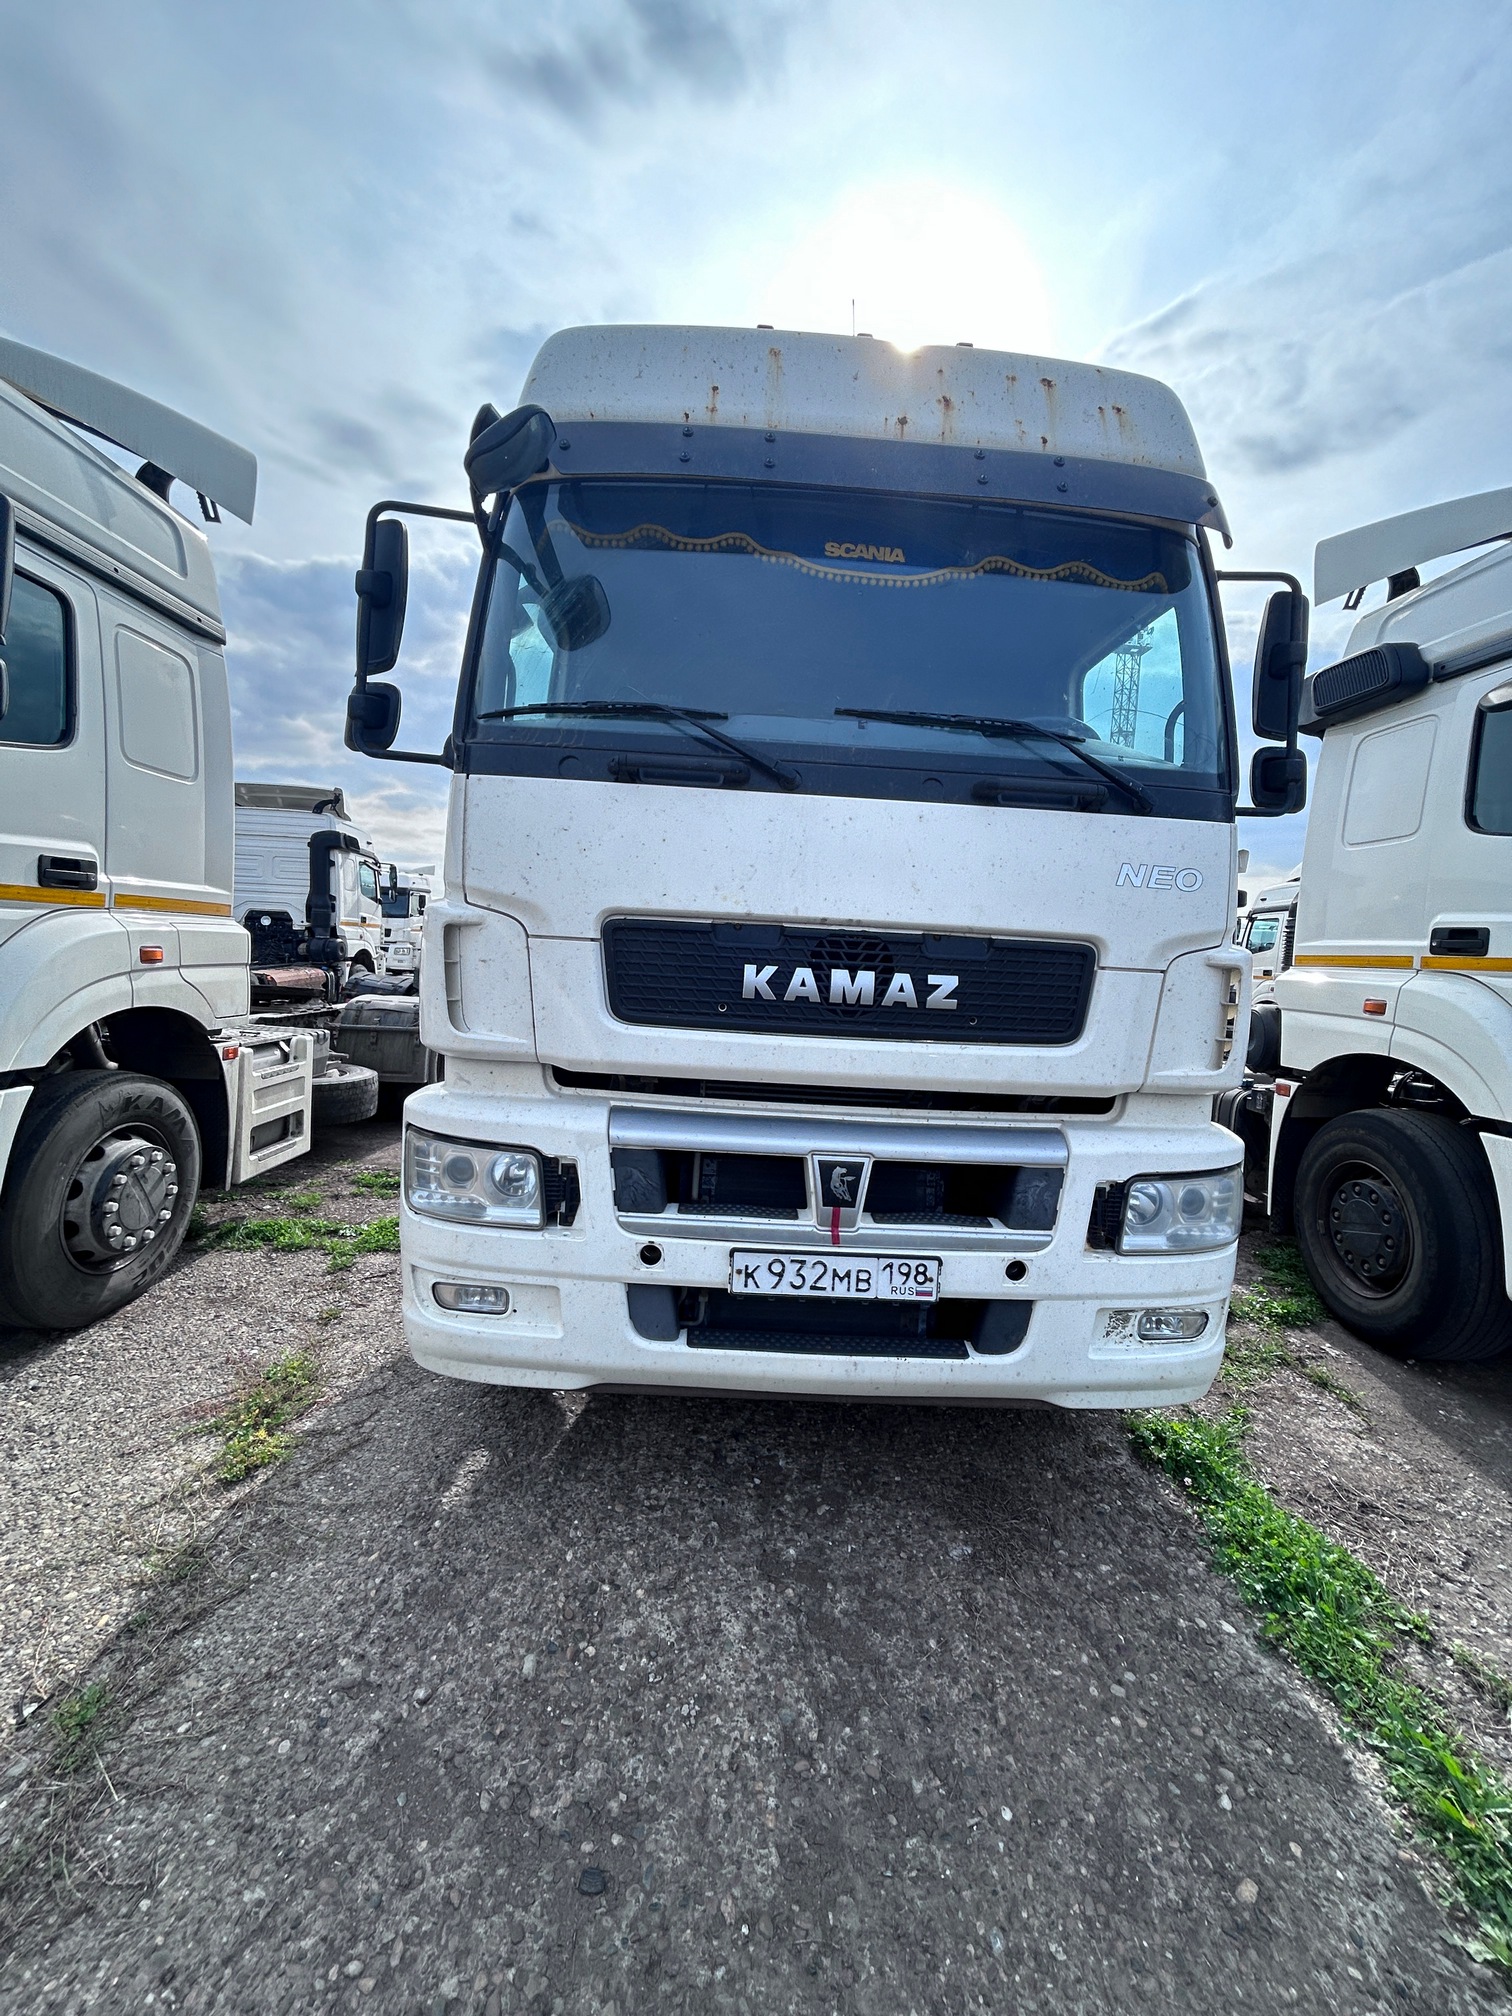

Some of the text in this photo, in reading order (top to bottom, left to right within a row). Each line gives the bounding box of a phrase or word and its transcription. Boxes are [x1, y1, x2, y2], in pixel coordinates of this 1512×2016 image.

[824, 542, 905, 563] SCANIA
[1115, 862, 1204, 892] NEO
[742, 964, 959, 1010] KAMAZ
[882, 1262, 928, 1286] 198
[890, 1285, 915, 1296] RUS
